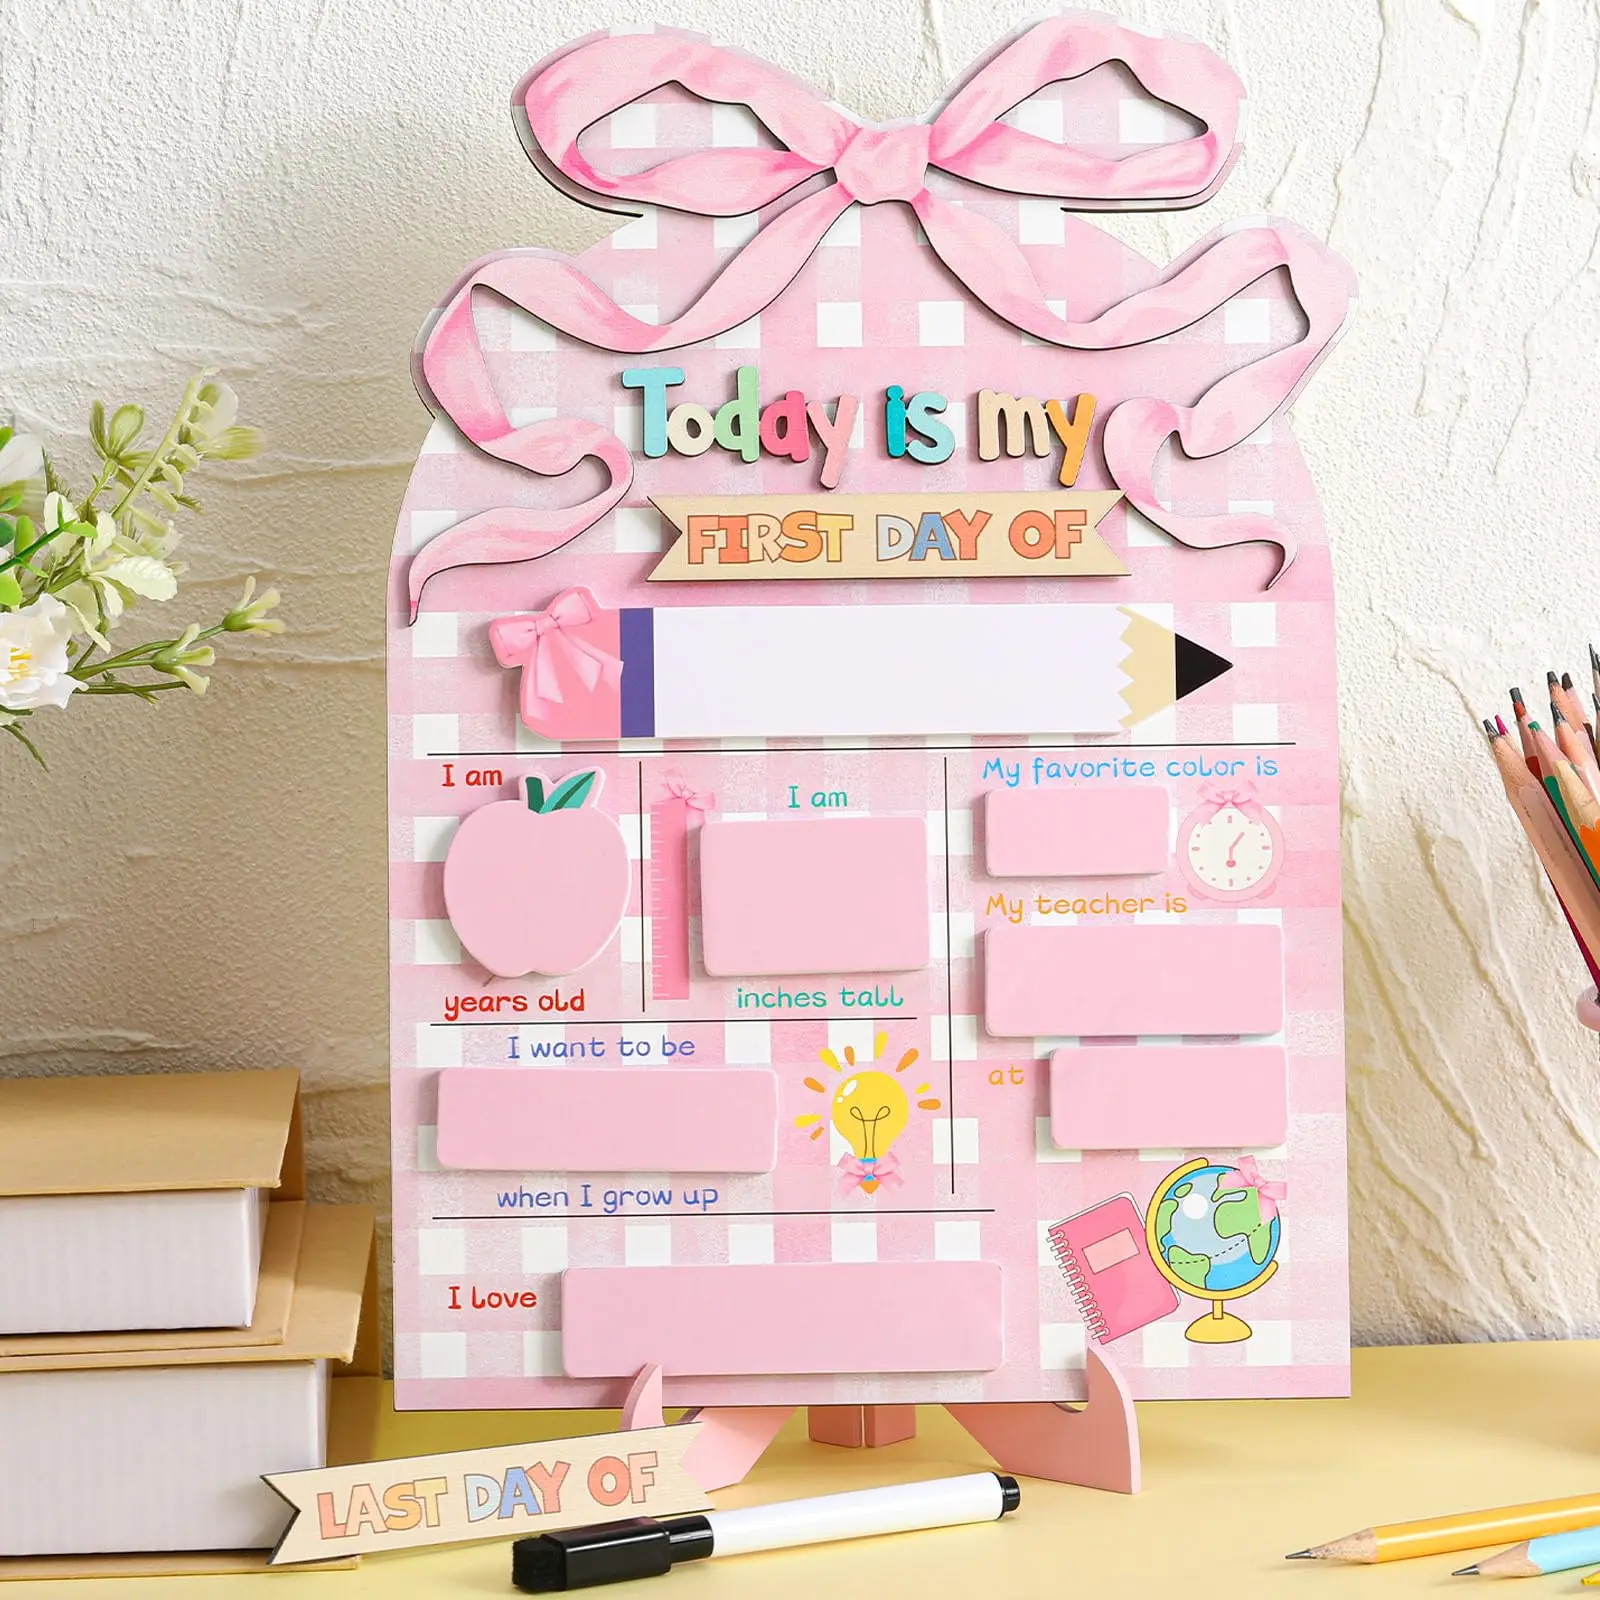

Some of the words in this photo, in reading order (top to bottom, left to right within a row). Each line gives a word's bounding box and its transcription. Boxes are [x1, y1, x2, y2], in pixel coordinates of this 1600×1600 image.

[621, 366, 859, 489] Today
[884, 384, 956, 465] is
[977, 388, 1097, 487] my
[687, 510, 854, 565] FIRST
[875, 508, 993, 562] DAY
[1007, 509, 1088, 560] OF
[442, 764, 455, 787] I
[465, 767, 503, 787] am
[982, 757, 1021, 787] My
[1032, 756, 1155, 785] favorite
[1166, 754, 1245, 777] color
[1256, 755, 1279, 776] is
[788, 785, 800, 808] I
[810, 788, 848, 808] am
[985, 893, 1024, 923] My
[1037, 892, 1155, 915] teacher
[1165, 892, 1188, 914] is
[444, 991, 528, 1021] years
[538, 988, 585, 1011] old
[736, 986, 828, 1009] inches
[838, 984, 904, 1007] tall
[507, 1036, 520, 1059] I
[530, 1036, 606, 1058] want
[619, 1035, 651, 1057] to
[661, 1035, 695, 1056] be
[988, 1063, 1025, 1086] at
[497, 1186, 569, 1208] when
[581, 1184, 593, 1207] I
[603, 1189, 673, 1213] grow
[683, 1188, 719, 1211] up
[448, 1286, 461, 1310] I
[471, 1285, 537, 1309] love
[316, 1476, 448, 1540] LAST
[463, 1460, 571, 1523] DAY
[587, 1451, 658, 1507] OF
